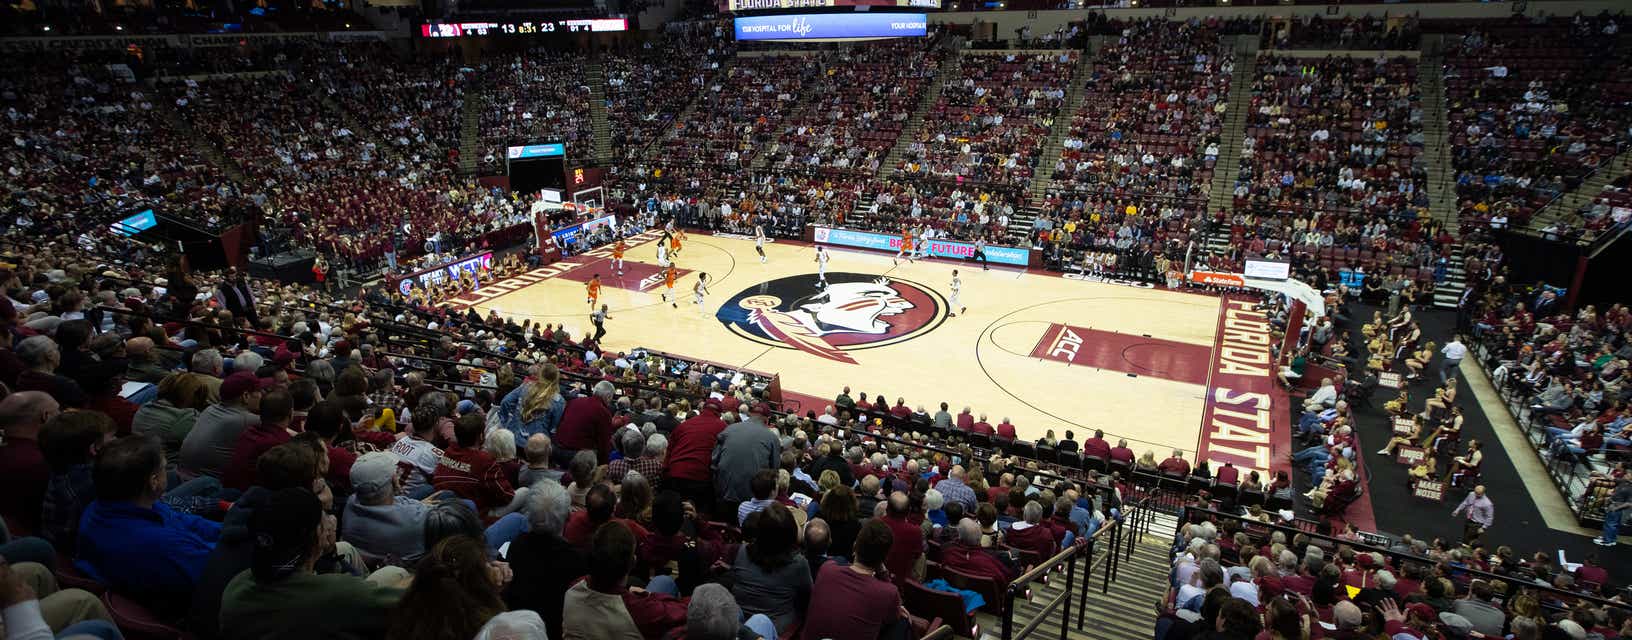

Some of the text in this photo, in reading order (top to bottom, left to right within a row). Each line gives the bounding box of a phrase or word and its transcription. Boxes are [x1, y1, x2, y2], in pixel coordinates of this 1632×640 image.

[501, 24, 516, 33] 13
[541, 23, 555, 32] 23
[778, 24, 791, 32] FOR
[792, 16, 813, 36] life
[1051, 329, 1085, 362] ACC
[1418, 480, 1443, 491] MAKE
[1415, 487, 1442, 500] NOISE
